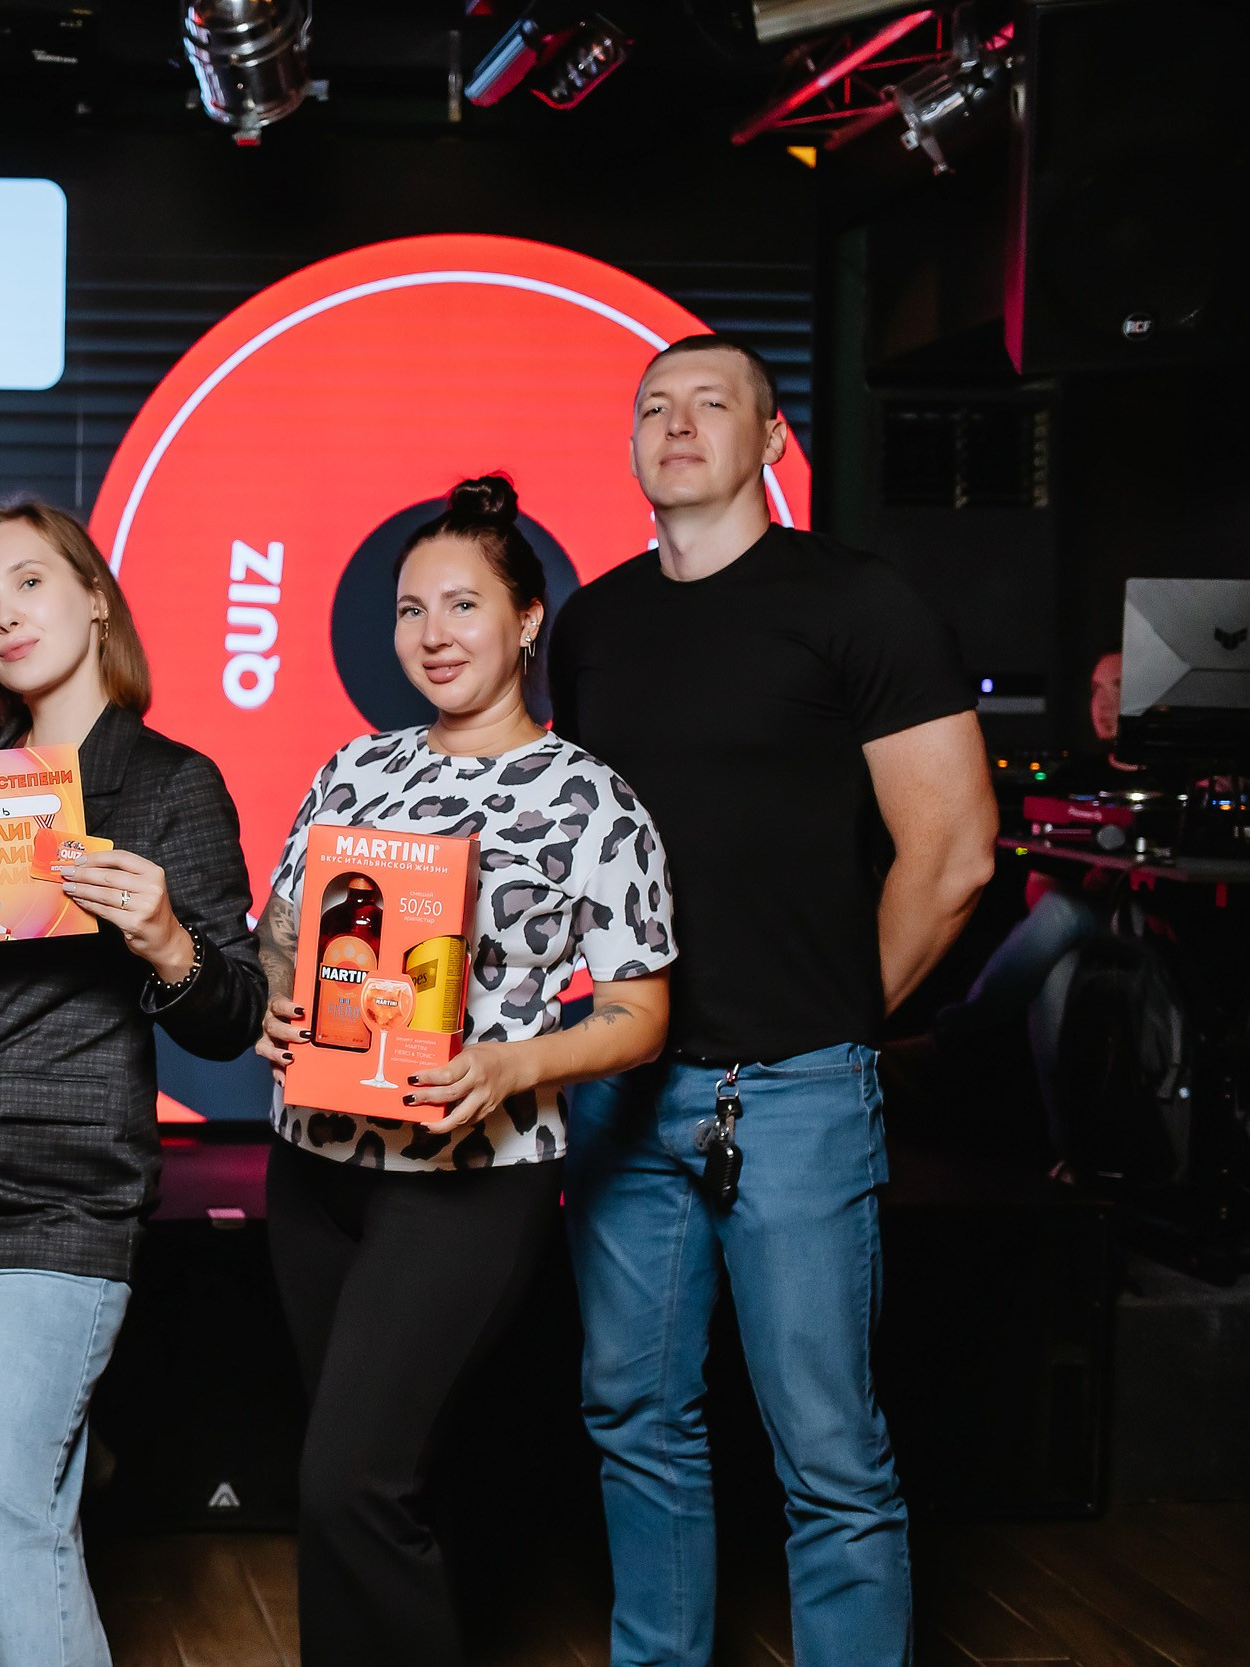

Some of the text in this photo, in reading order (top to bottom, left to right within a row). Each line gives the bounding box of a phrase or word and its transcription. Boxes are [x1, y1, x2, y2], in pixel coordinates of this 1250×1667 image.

[221, 539, 285, 710] QUIZ
[320, 855, 448, 874] ВКУС ИТАЛЬЯНСКОЙ ЖИЗНИ
[399, 898, 443, 916] 50/50
